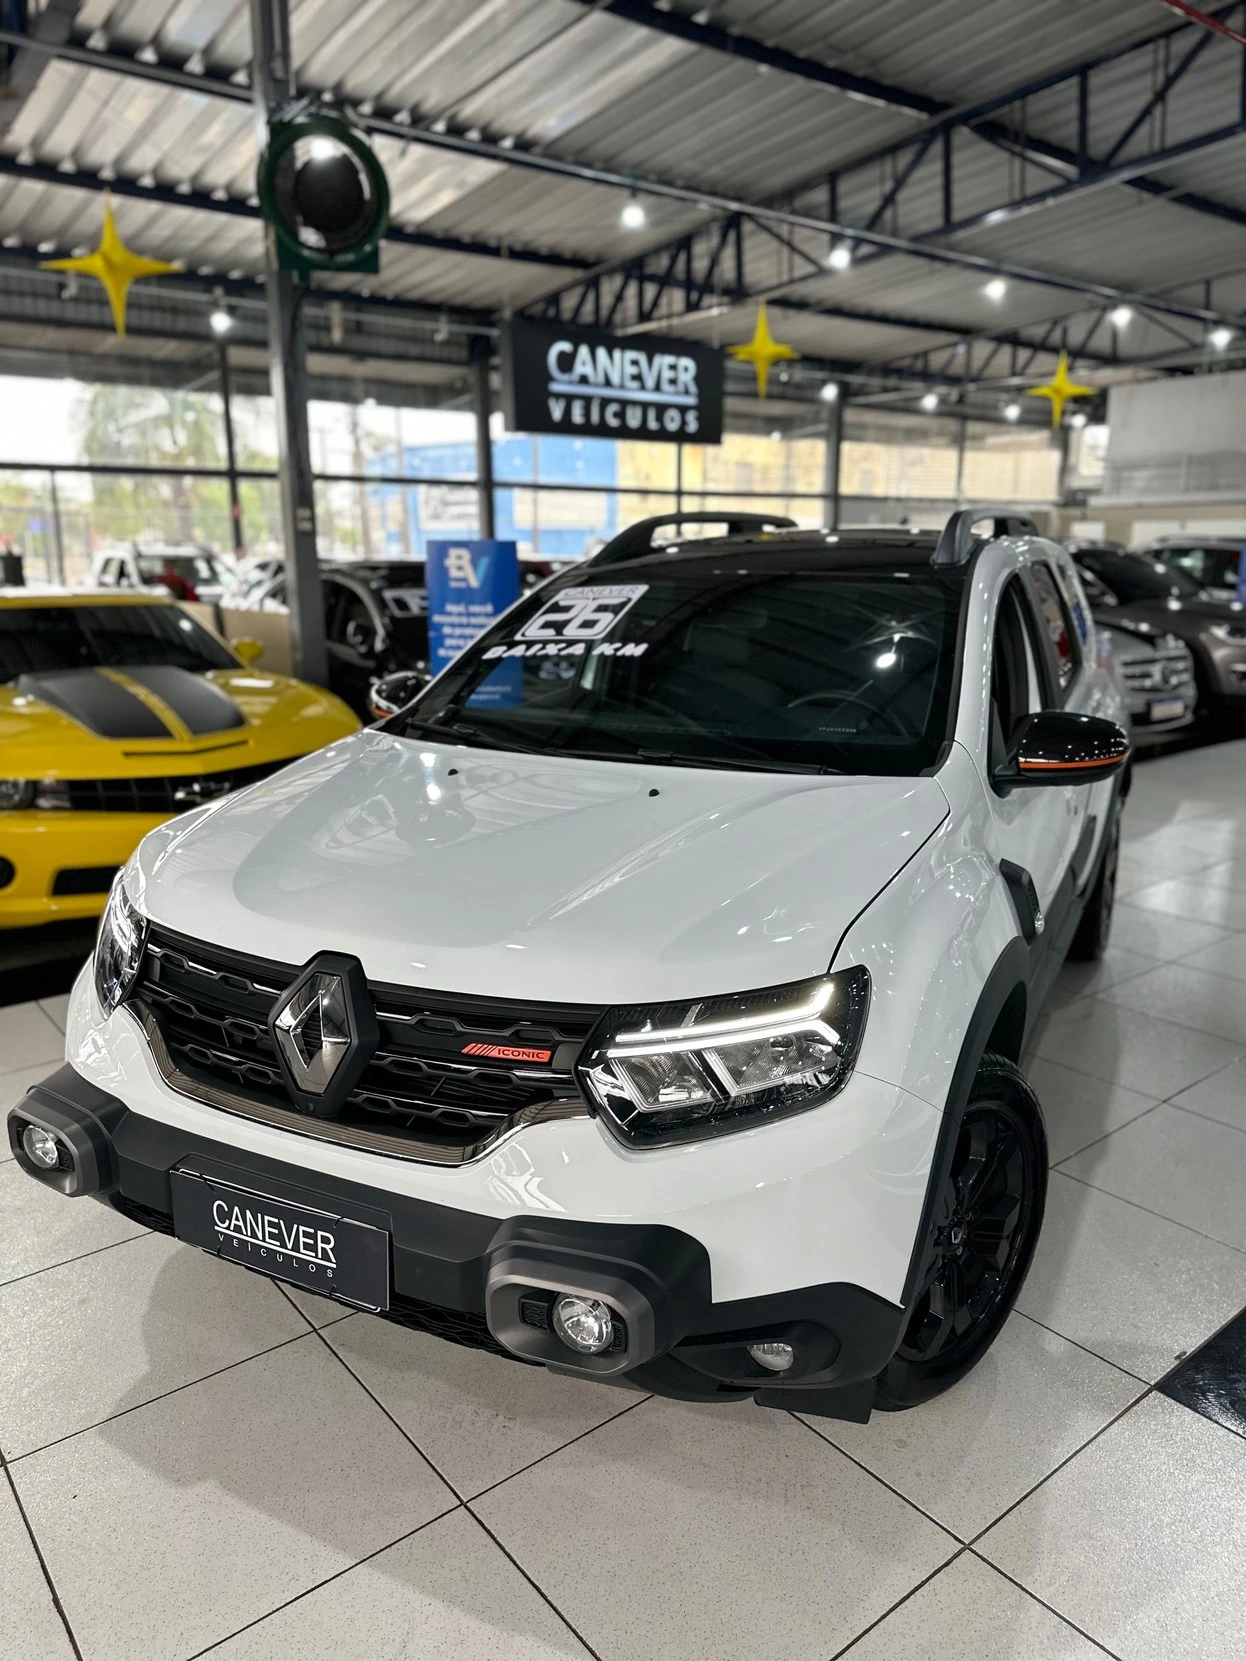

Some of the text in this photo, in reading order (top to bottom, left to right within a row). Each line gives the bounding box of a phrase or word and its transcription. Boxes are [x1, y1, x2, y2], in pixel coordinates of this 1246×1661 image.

[547, 340, 699, 395] CANEVER
[548, 397, 699, 433] VEÍCULOS
[564, 586, 639, 598] CANEVER
[524, 598, 627, 637] 26
[481, 643, 586, 660] BAIXA
[592, 643, 649, 657] KM
[497, 1048, 545, 1060] ICONIC
[212, 1200, 337, 1263] CANEVER
